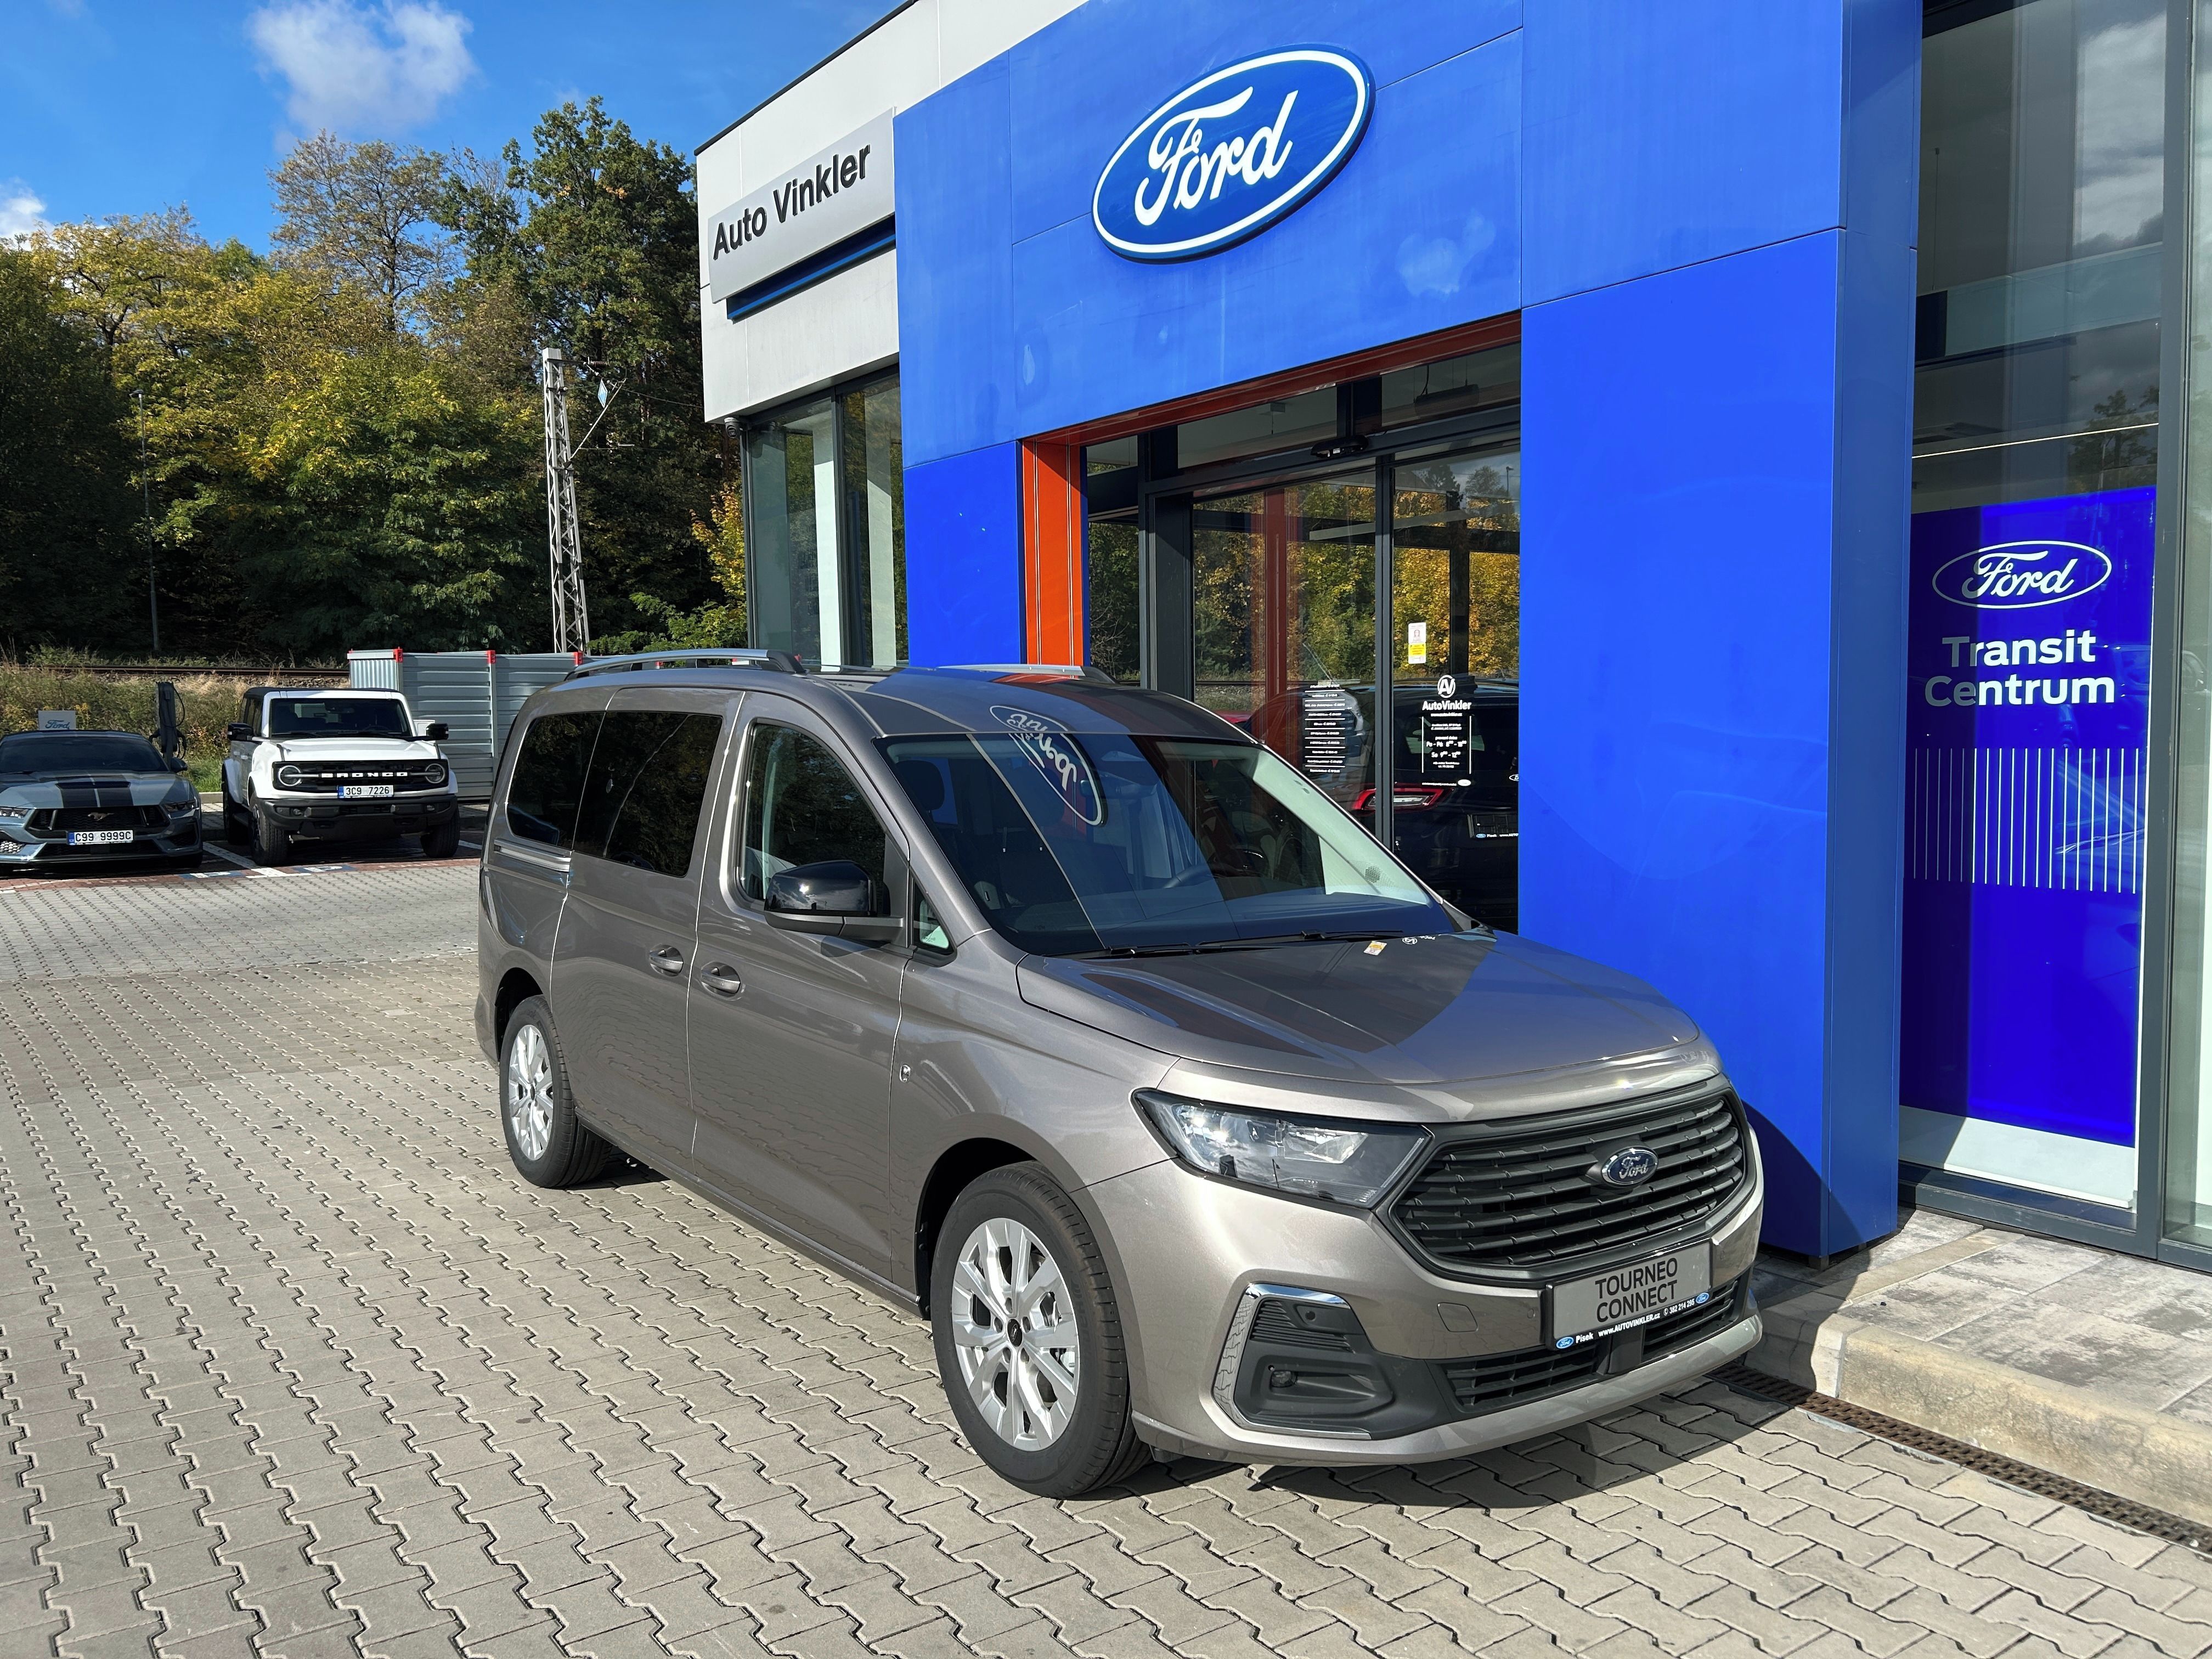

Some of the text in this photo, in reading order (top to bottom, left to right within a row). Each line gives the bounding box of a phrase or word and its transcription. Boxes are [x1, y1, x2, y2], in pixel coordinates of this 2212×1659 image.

[1134, 86, 1299, 226] Ford
[713, 144, 871, 261] Auto Vinkler
[1962, 550, 2078, 599] Ford
[1942, 629, 2096, 668] Transit
[1422, 700, 1472, 710] AutoVinkler
[1925, 674, 2114, 707] Centrum
[368, 787, 390, 795] 7226
[75, 831, 131, 842] C99 9999C
[1619, 1155, 1649, 1179] Ford
[1595, 1257, 1678, 1299] TOURNEO
[1596, 1280, 1678, 1323] CONNECT
[1598, 1313, 1660, 1336] www.AUTOVINKLER.cz
